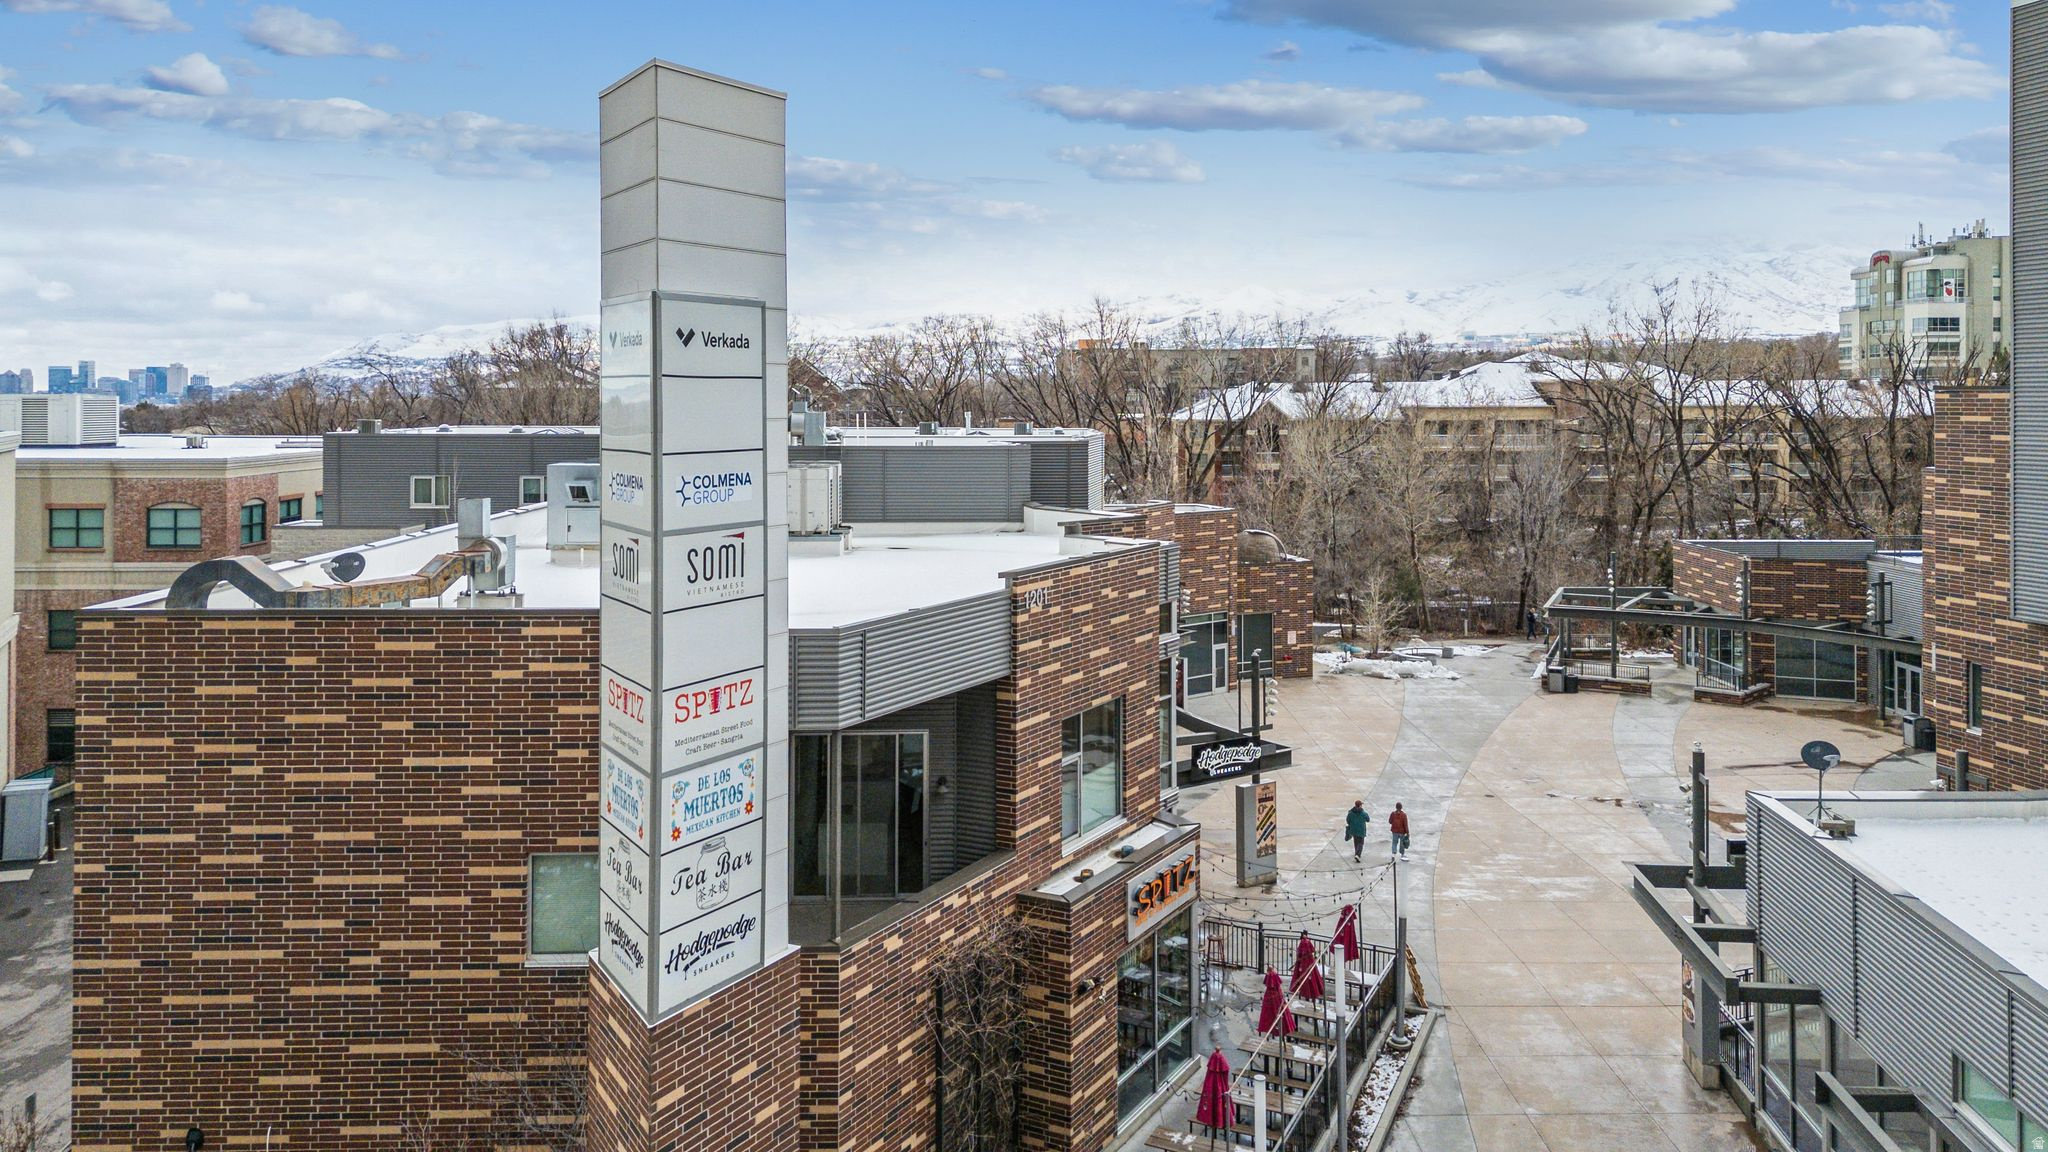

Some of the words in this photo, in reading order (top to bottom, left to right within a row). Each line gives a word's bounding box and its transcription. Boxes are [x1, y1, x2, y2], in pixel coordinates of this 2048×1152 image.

[620, 331, 643, 347] Verkada
[701, 331, 750, 349] Verkada
[615, 473, 644, 490] COLMENA
[693, 472, 752, 489] COLMENA
[615, 487, 635, 503] GROUP
[693, 488, 734, 504] GROUP
[687, 581, 744, 596] VIETNAMESE
[1025, 588, 1048, 609] 1201
[608, 679, 644, 723] SPITZ
[674, 679, 754, 724] SPITZ
[674, 729, 720, 747] Mediterranean
[720, 722, 739, 734] Street
[740, 718, 754, 729] Food
[685, 744, 702, 756] Craft
[720, 733, 743, 745] Sangria
[1197, 743, 1261, 769] Hodgepodge
[698, 775, 711, 792] DE
[714, 768, 731, 785] LOS
[612, 782, 639, 820] MUERTOS
[683, 782, 744, 822] MUERTOS
[685, 816, 714, 836] MEXICAN
[715, 807, 741, 824] KITCHEN
[607, 846, 622, 876] Tea
[624, 860, 642, 894] Bar
[671, 867, 707, 896] Tea
[715, 851, 753, 878] Bar
[1138, 855, 1196, 917] SPITZ
[665, 913, 756, 974] Hodgepodge
[694, 951, 735, 976] SNEAKERS
